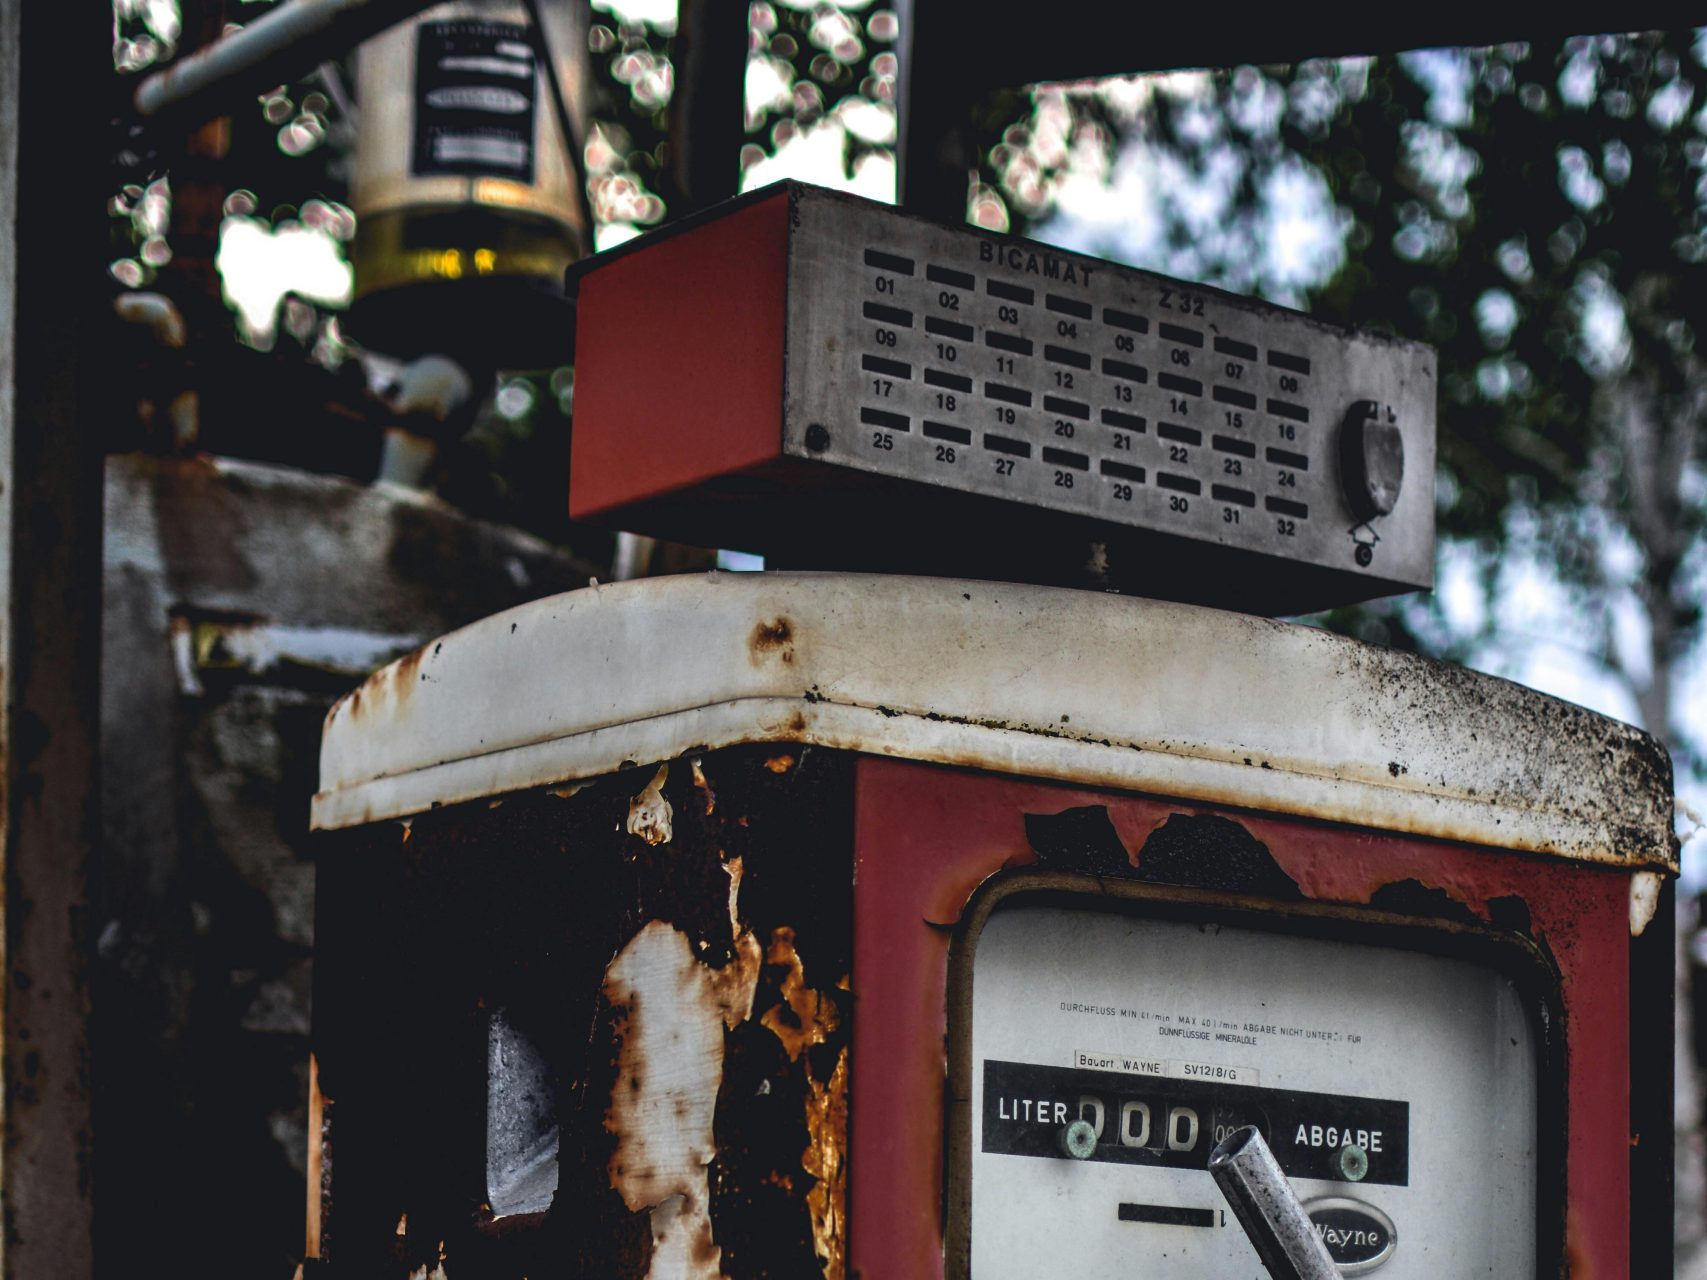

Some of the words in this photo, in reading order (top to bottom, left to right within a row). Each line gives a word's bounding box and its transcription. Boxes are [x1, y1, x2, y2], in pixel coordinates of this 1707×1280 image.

[979, 241, 1093, 287] BICAMAT
[1159, 287, 1172, 309] Z
[1179, 292, 1204, 317] 32
[876, 276, 894, 295] 01
[939, 292, 959, 311] 02
[998, 306, 1018, 325] 03
[1057, 321, 1077, 339] 04
[1115, 335, 1134, 353] 05
[1171, 349, 1190, 366] 06
[1225, 362, 1243, 379] 07
[1280, 376, 1298, 393] 08
[876, 329, 896, 347] 09
[937, 344, 956, 362] 10
[997, 357, 1013, 374] 11
[1055, 371, 1073, 389] 12
[1115, 385, 1132, 402] 13
[1171, 399, 1188, 415] 14
[1226, 412, 1242, 428] 15
[1279, 424, 1294, 440] 16
[873, 380, 892, 397] 17
[937, 394, 955, 411] 18
[996, 407, 1015, 424] 19
[1055, 420, 1074, 438] 20
[1114, 433, 1130, 450] 21
[1170, 446, 1188, 464] 22
[1224, 459, 1242, 476] 23
[1278, 471, 1295, 487] 24
[873, 433, 893, 450] 25
[936, 445, 955, 463] 26
[996, 459, 1015, 475] 27
[1055, 471, 1073, 488] 28
[1114, 484, 1132, 501] 29
[1170, 496, 1188, 513] 30
[1224, 508, 1239, 524] 31
[1278, 519, 1294, 536] 32
[1060, 1002, 1116, 1016] DURCHFLUSS
[1120, 1009, 1137, 1018] MIN
[1178, 1016, 1196, 1025] MAX
[1243, 1023, 1277, 1035] ABGABE
[1280, 1027, 1303, 1037] NICHT
[1122, 1059, 1160, 1073] WAYNE
[1184, 1064, 1237, 1080] SV12/8/G
[1000, 1097, 1067, 1124] LITER
[1295, 1124, 1382, 1152] ABGABE
